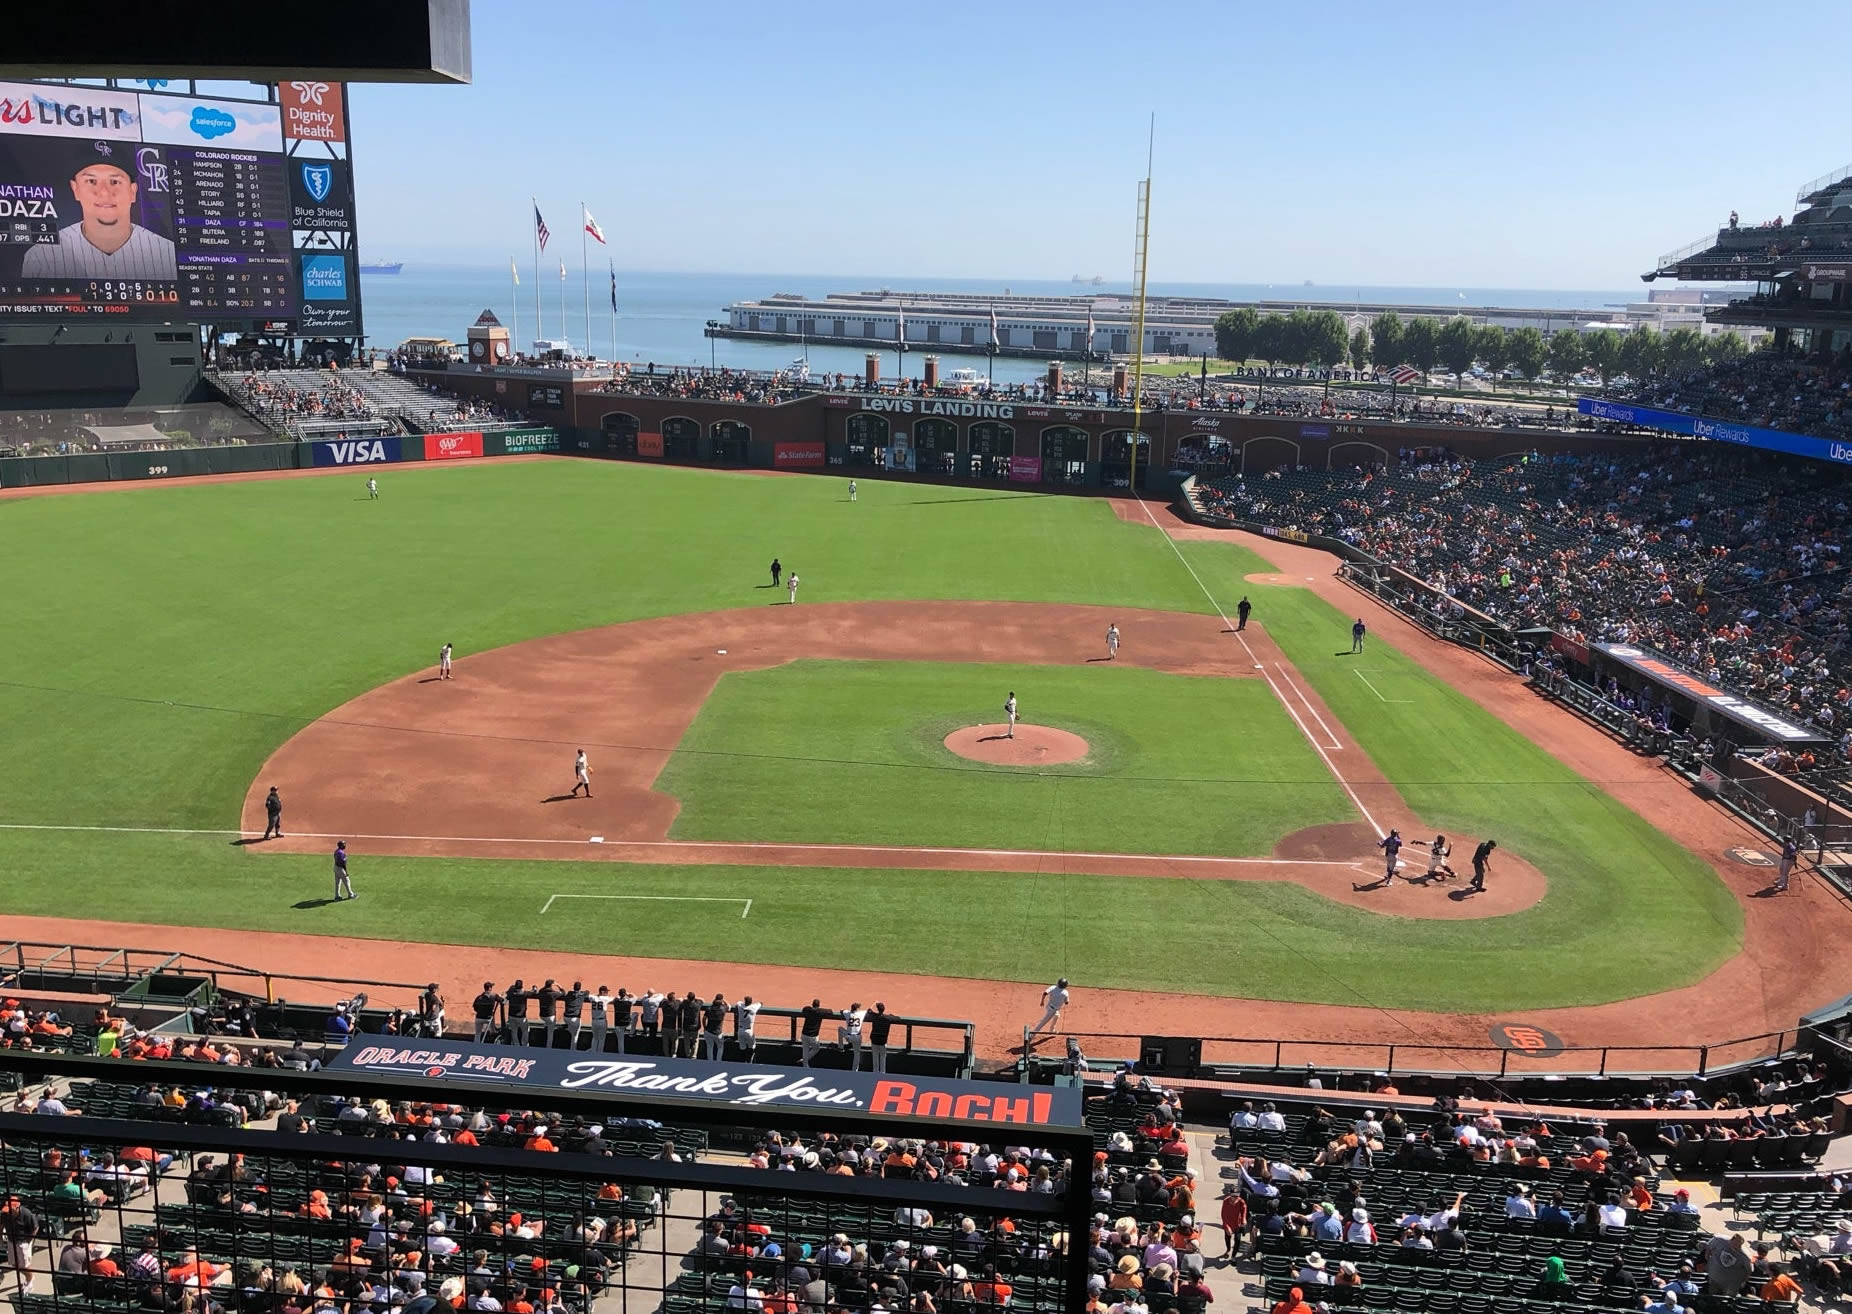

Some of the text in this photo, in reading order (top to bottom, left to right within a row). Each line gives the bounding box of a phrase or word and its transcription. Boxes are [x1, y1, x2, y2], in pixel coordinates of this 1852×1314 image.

[38, 101, 123, 130] LIGHT
[289, 107, 335, 126] Dignity
[195, 118, 232, 128] salesforce
[293, 123, 335, 138] Health
[195, 151, 258, 162] COLORADO ROCKIES
[0, 184, 54, 198] NATHAN
[0, 200, 58, 218] DAZA
[295, 206, 344, 217] Blue Shield
[292, 217, 348, 228] of California
[306, 266, 342, 279] charles
[105, 282, 111, 290] 0
[106, 292, 112, 300] 3
[146, 290, 154, 301] 0
[159, 290, 164, 301] 1
[169, 290, 177, 301] 0
[303, 305, 350, 320] Own your
[303, 318, 353, 327] tomorrow
[1236, 366, 1381, 381] BANK OF AMERICA
[920, 400, 1014, 419] LANDING
[1590, 402, 1634, 421] Uber Rewards
[1192, 417, 1220, 427] Alaska
[1693, 420, 1750, 443] Uber Rewards
[505, 434, 559, 446] BIOFREEZE
[326, 440, 386, 464] VISA
[149, 466, 168, 474] 399
[1113, 479, 1129, 487] 309
[592, 1001, 604, 1010] 26
[744, 1010, 750, 1018] 7
[848, 1018, 860, 1026] 23
[352, 1046, 537, 1079] ORACLE PARK
[560, 1061, 728, 1094] Thank
[730, 1072, 864, 1106] You,
